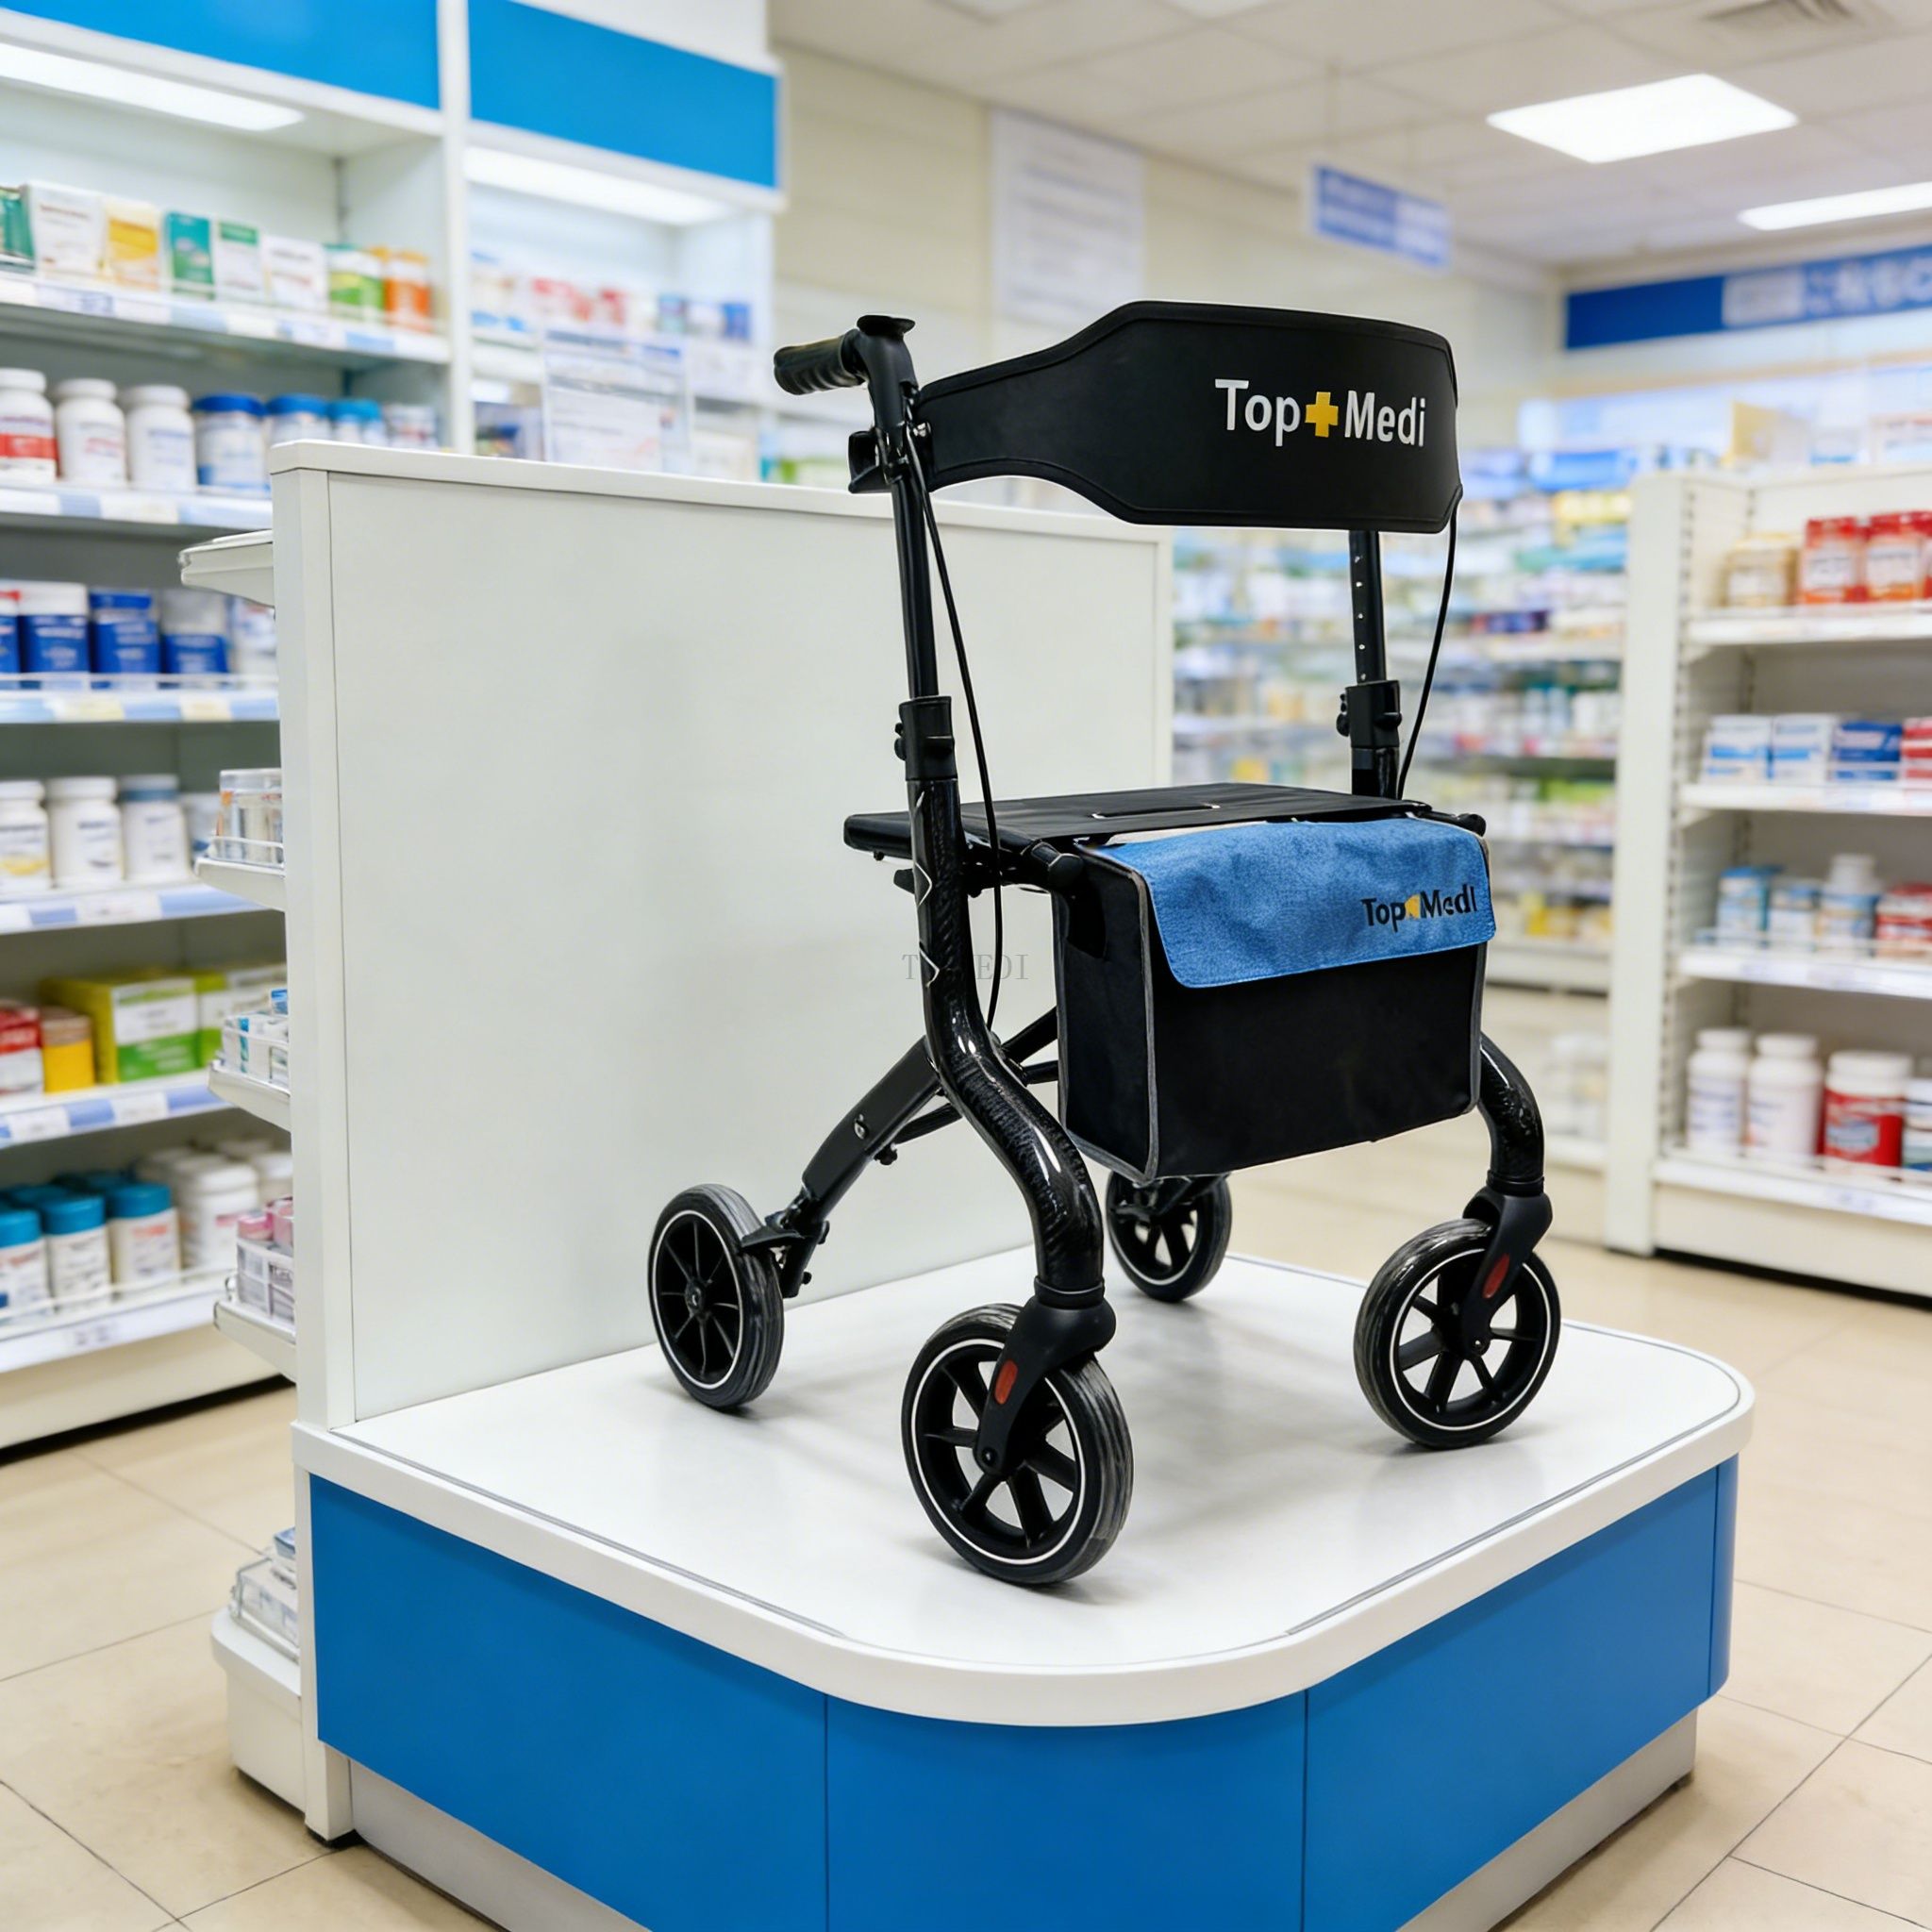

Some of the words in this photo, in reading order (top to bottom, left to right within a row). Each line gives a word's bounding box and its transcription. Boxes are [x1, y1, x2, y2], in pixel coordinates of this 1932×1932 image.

[1214, 378, 1301, 447] Top
[1344, 390, 1426, 447] Medi
[1360, 897, 1407, 933] Top
